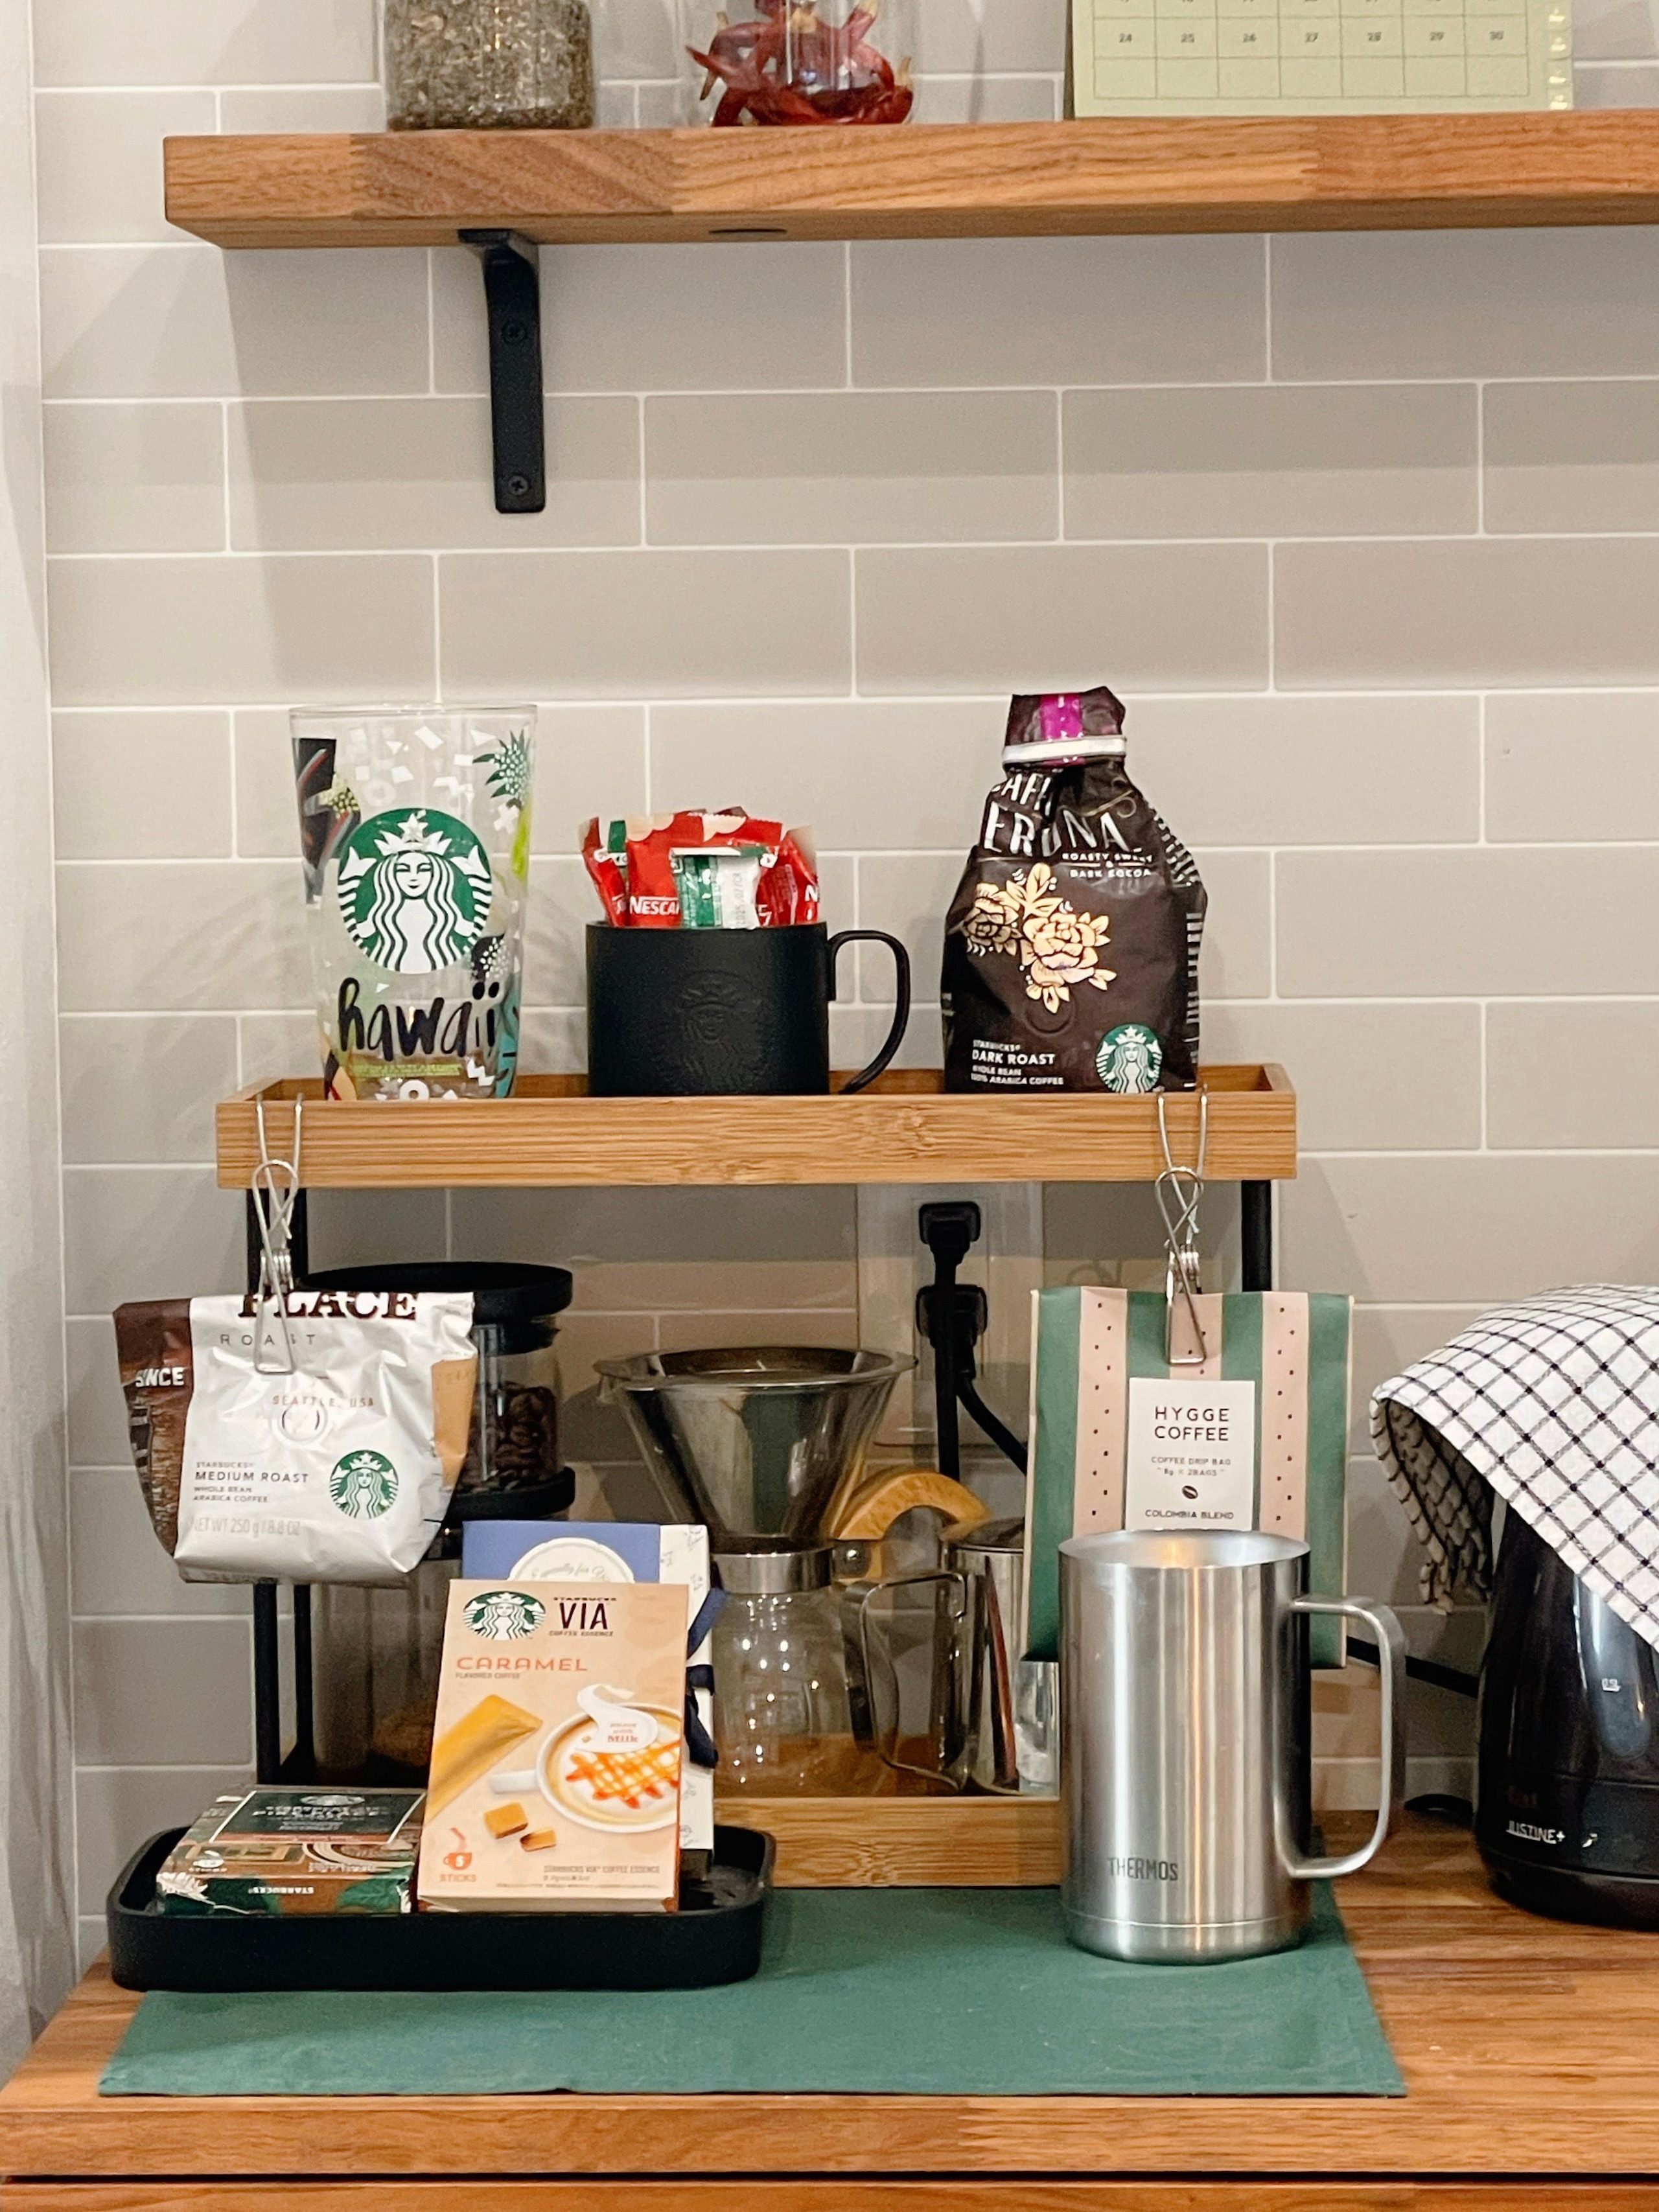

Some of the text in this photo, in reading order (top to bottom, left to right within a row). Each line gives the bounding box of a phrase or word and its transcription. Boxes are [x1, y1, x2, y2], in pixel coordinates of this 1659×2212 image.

[1119, 30, 1504, 43] 24 25 26 27 28 29 30
[1069, 868, 1152, 878] DARK COCOA
[337, 977, 500, 1062] hawaii
[972, 1050, 1055, 1065] DARK ROAST
[990, 1076, 1027, 1085] ARABICA
[349, 1397, 374, 1407] USA
[1155, 1406, 1230, 1422] HYGGE
[1154, 1425, 1229, 1442] COFFEE
[1151, 1456, 1185, 1464] COFFEE
[195, 1471, 308, 1482] MEDIUM ROAST
[1145, 1509, 1197, 1518] COLOMBIA
[230, 1518, 250, 1533] 250
[559, 1602, 607, 1630] VIA
[456, 1657, 587, 1671] CARAMEL
[1107, 1858, 1178, 1881] THERMOS
